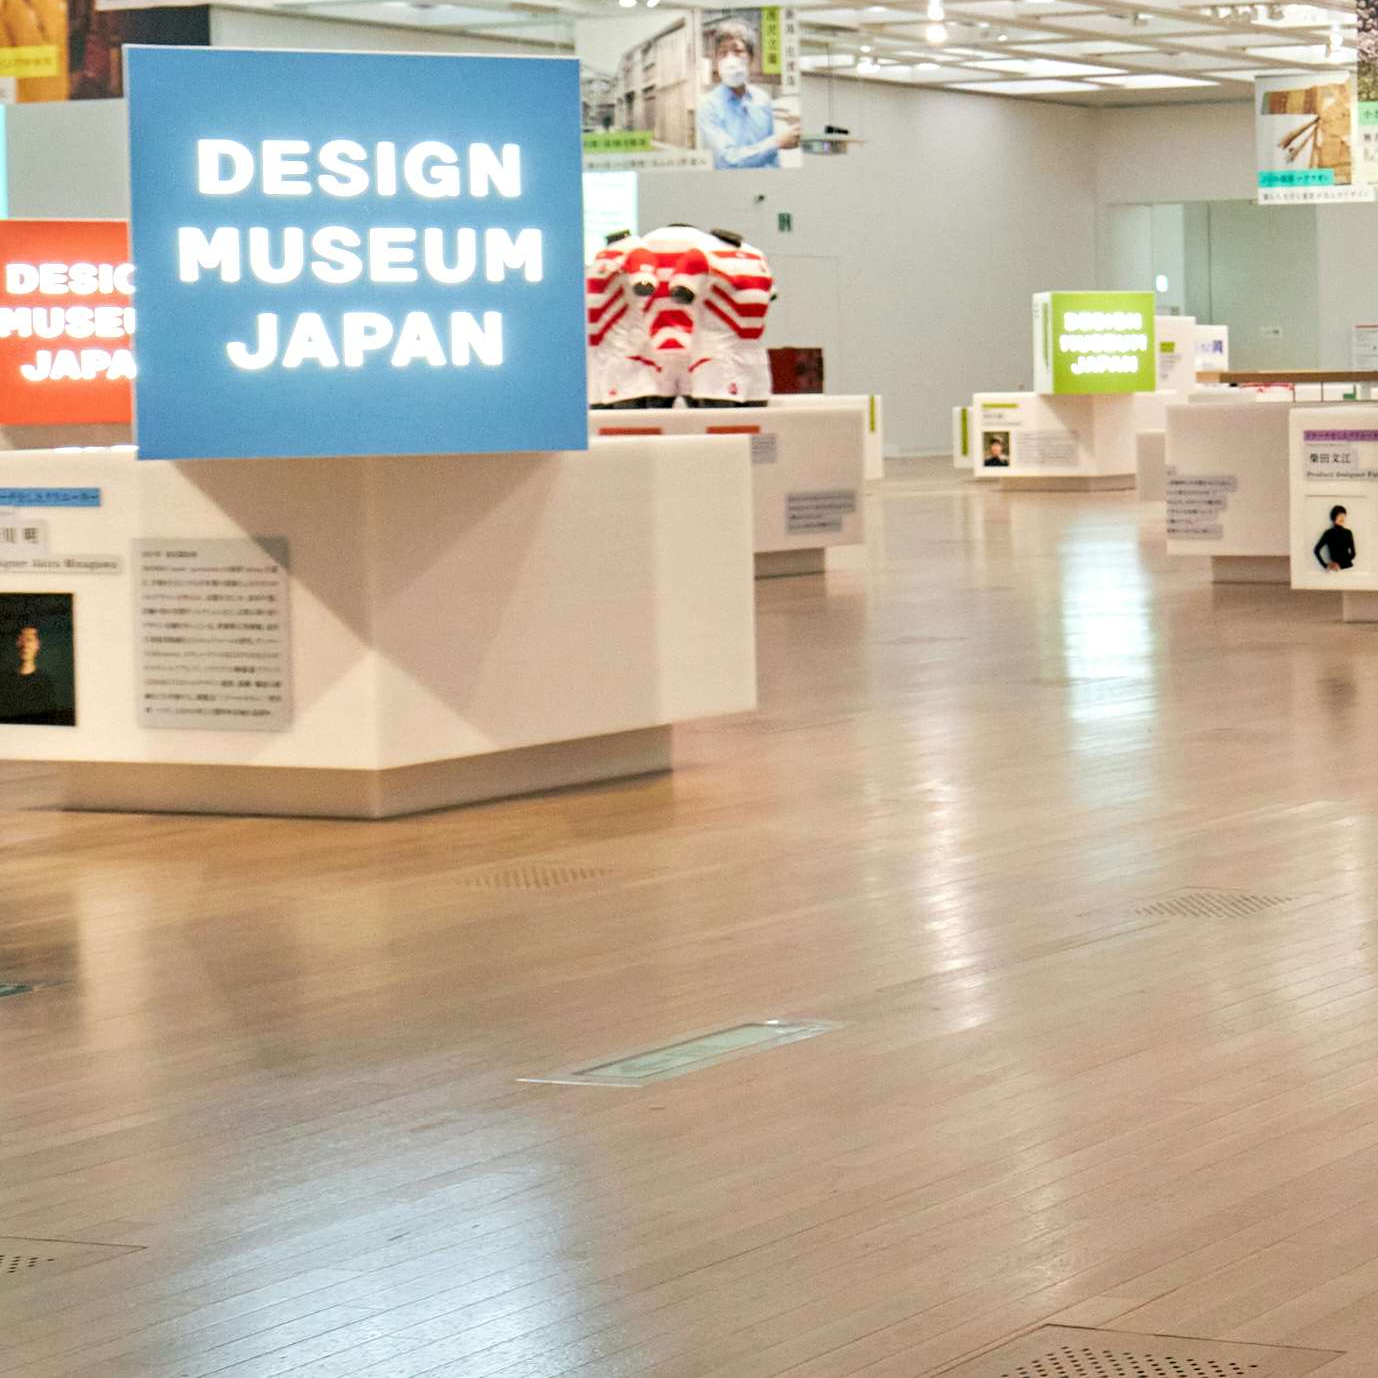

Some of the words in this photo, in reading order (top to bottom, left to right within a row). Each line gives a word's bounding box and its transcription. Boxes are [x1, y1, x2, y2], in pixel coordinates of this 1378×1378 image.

[198, 139, 522, 198] DESIGN
[6, 263, 137, 295] DESIG
[178, 225, 545, 284] MUSEUM
[20, 349, 137, 381] JAPA
[226, 310, 503, 370] JAPAN
